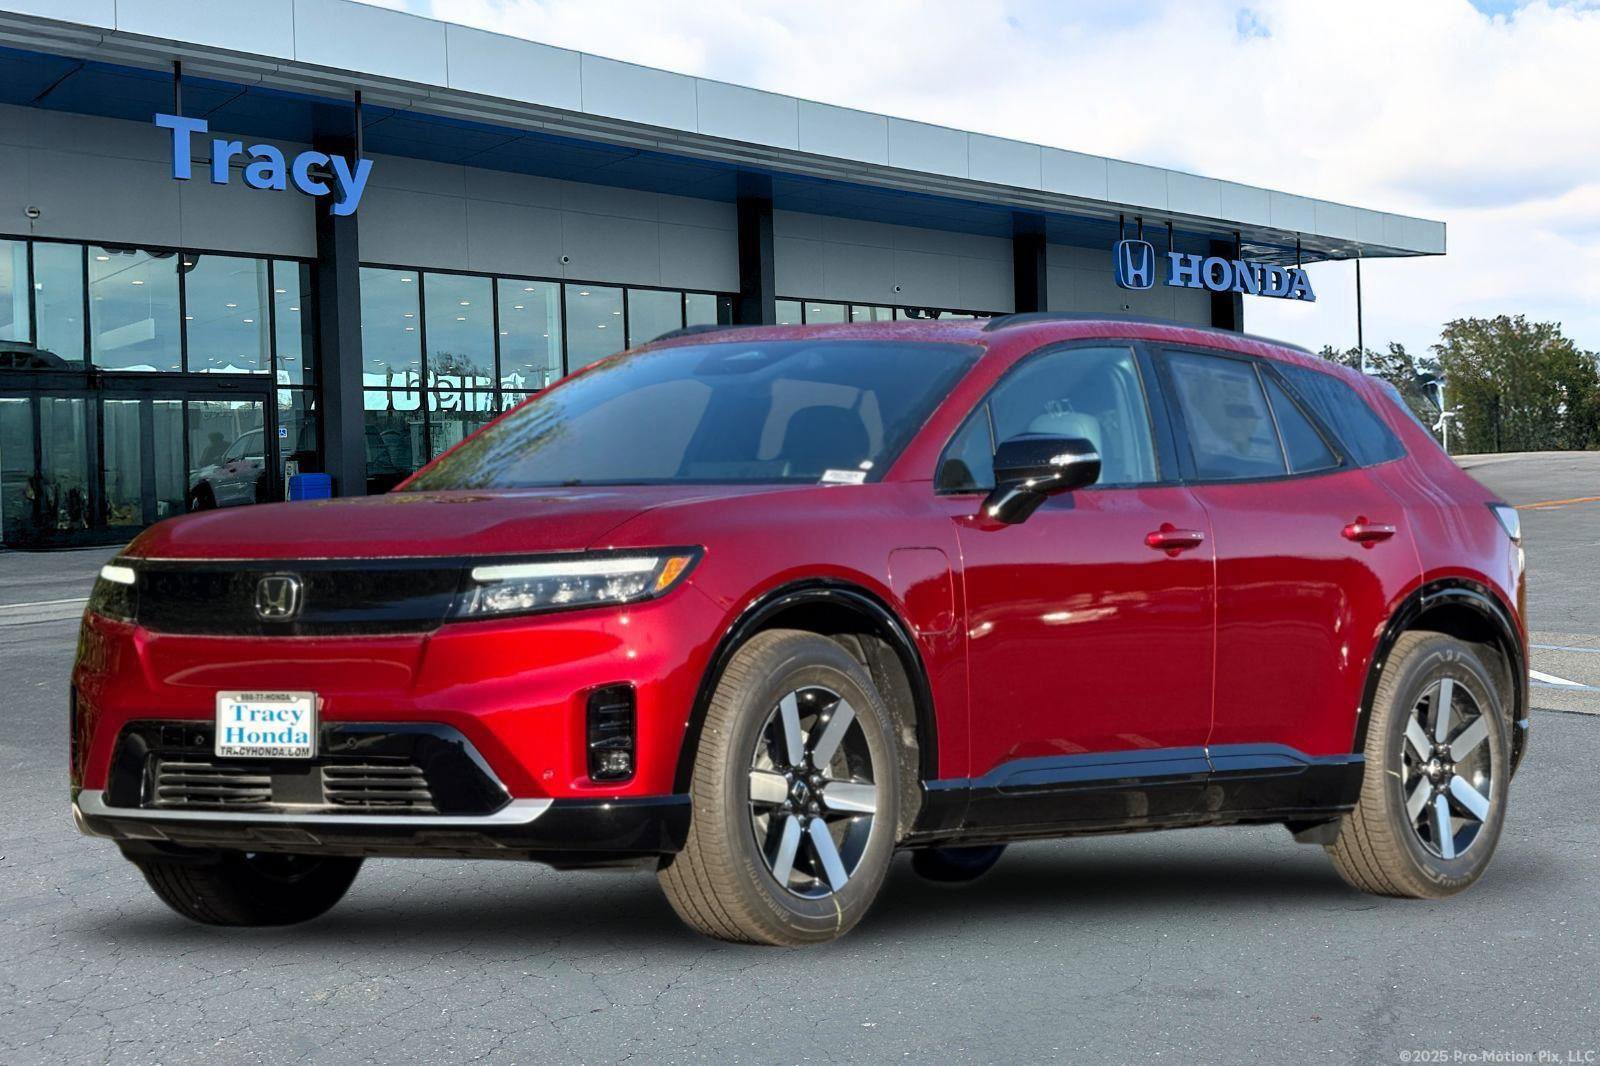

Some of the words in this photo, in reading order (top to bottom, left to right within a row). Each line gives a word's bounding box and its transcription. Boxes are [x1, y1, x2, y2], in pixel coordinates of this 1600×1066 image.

[154, 113, 374, 216] Tracy
[1167, 251, 1317, 301] HONDA
[229, 704, 304, 726] Tracy
[225, 726, 308, 744] Honda
